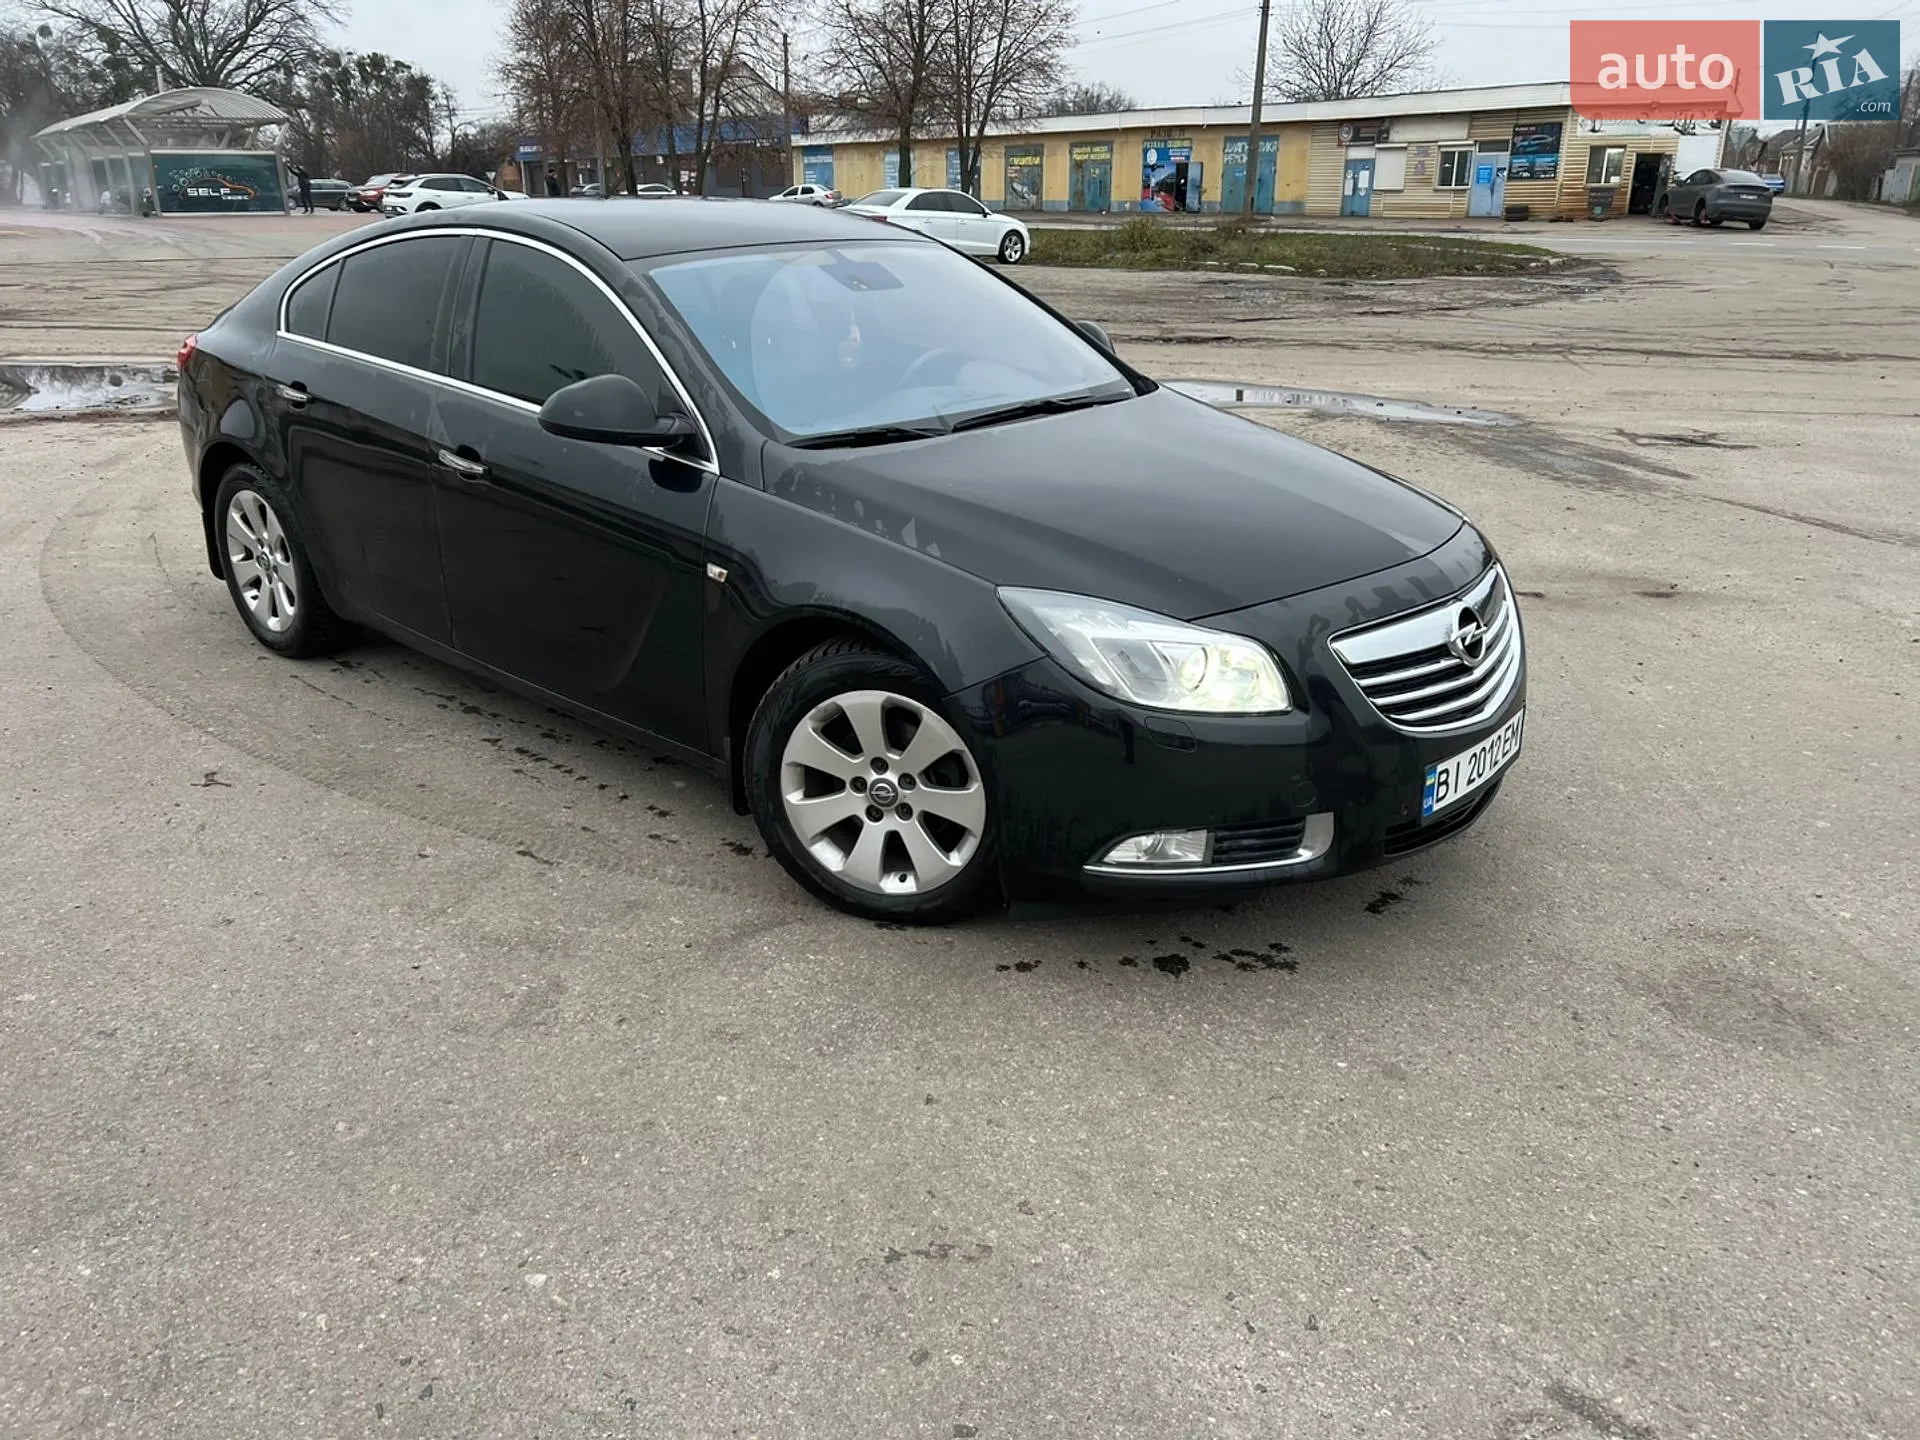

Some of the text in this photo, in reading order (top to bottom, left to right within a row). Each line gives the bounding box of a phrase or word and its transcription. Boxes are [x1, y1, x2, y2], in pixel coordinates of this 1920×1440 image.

[187, 187, 231, 196] SELF
[1436, 761, 1460, 804] BI
[1467, 734, 1501, 786] 2012
